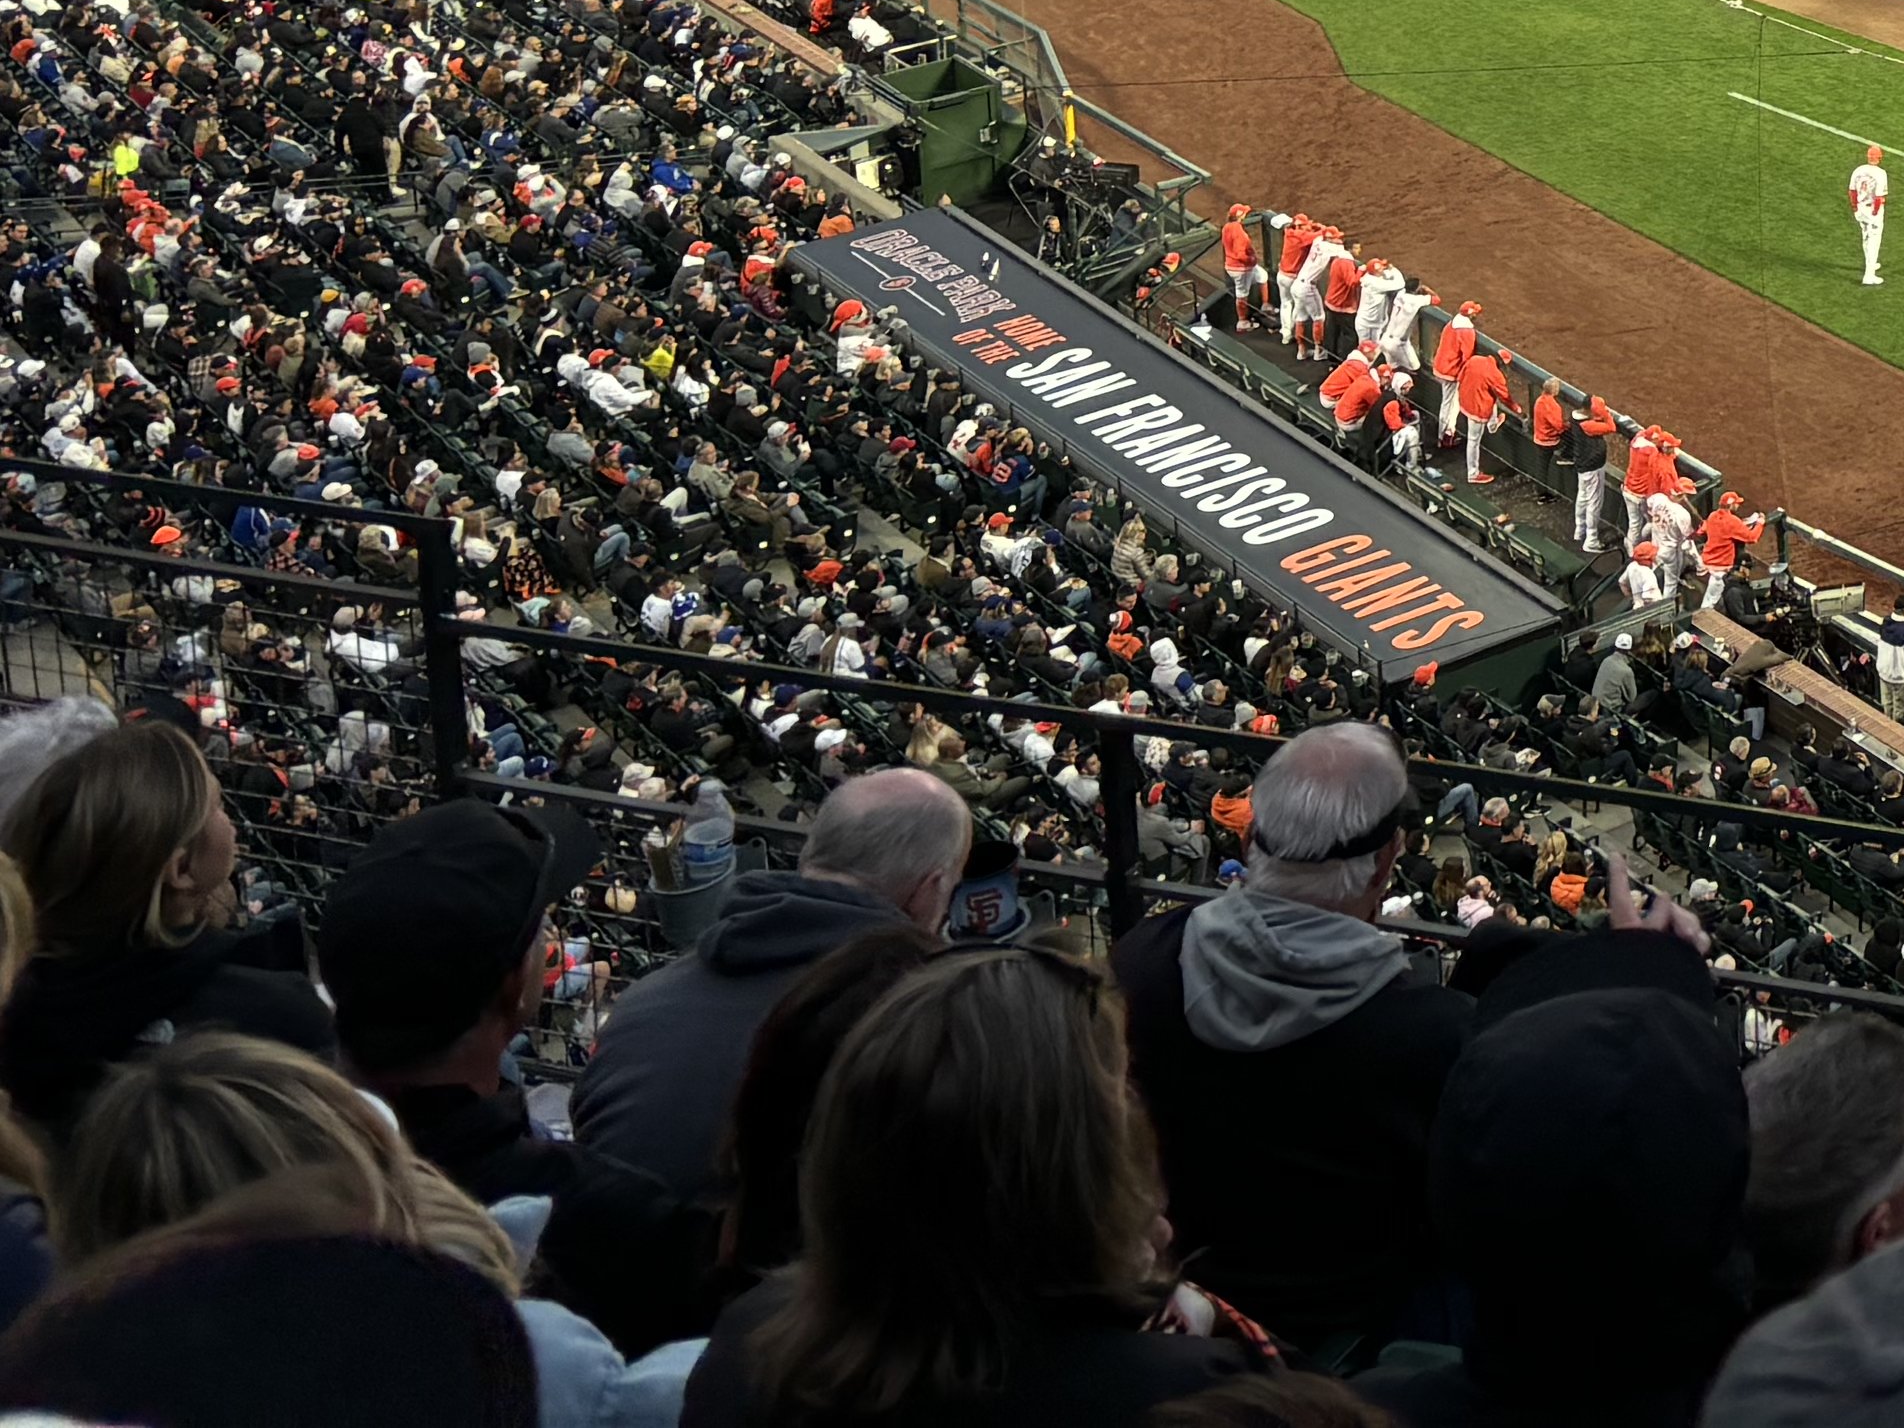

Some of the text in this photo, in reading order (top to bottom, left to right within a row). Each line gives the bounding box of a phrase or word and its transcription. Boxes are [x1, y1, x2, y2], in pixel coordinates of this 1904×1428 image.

[850, 228, 1017, 324] ORACLE PARK
[952, 328, 1021, 365] OF THE
[992, 313, 1067, 351] HOME
[1005, 347, 1485, 650] SAN FRANCISCO GIANTS
